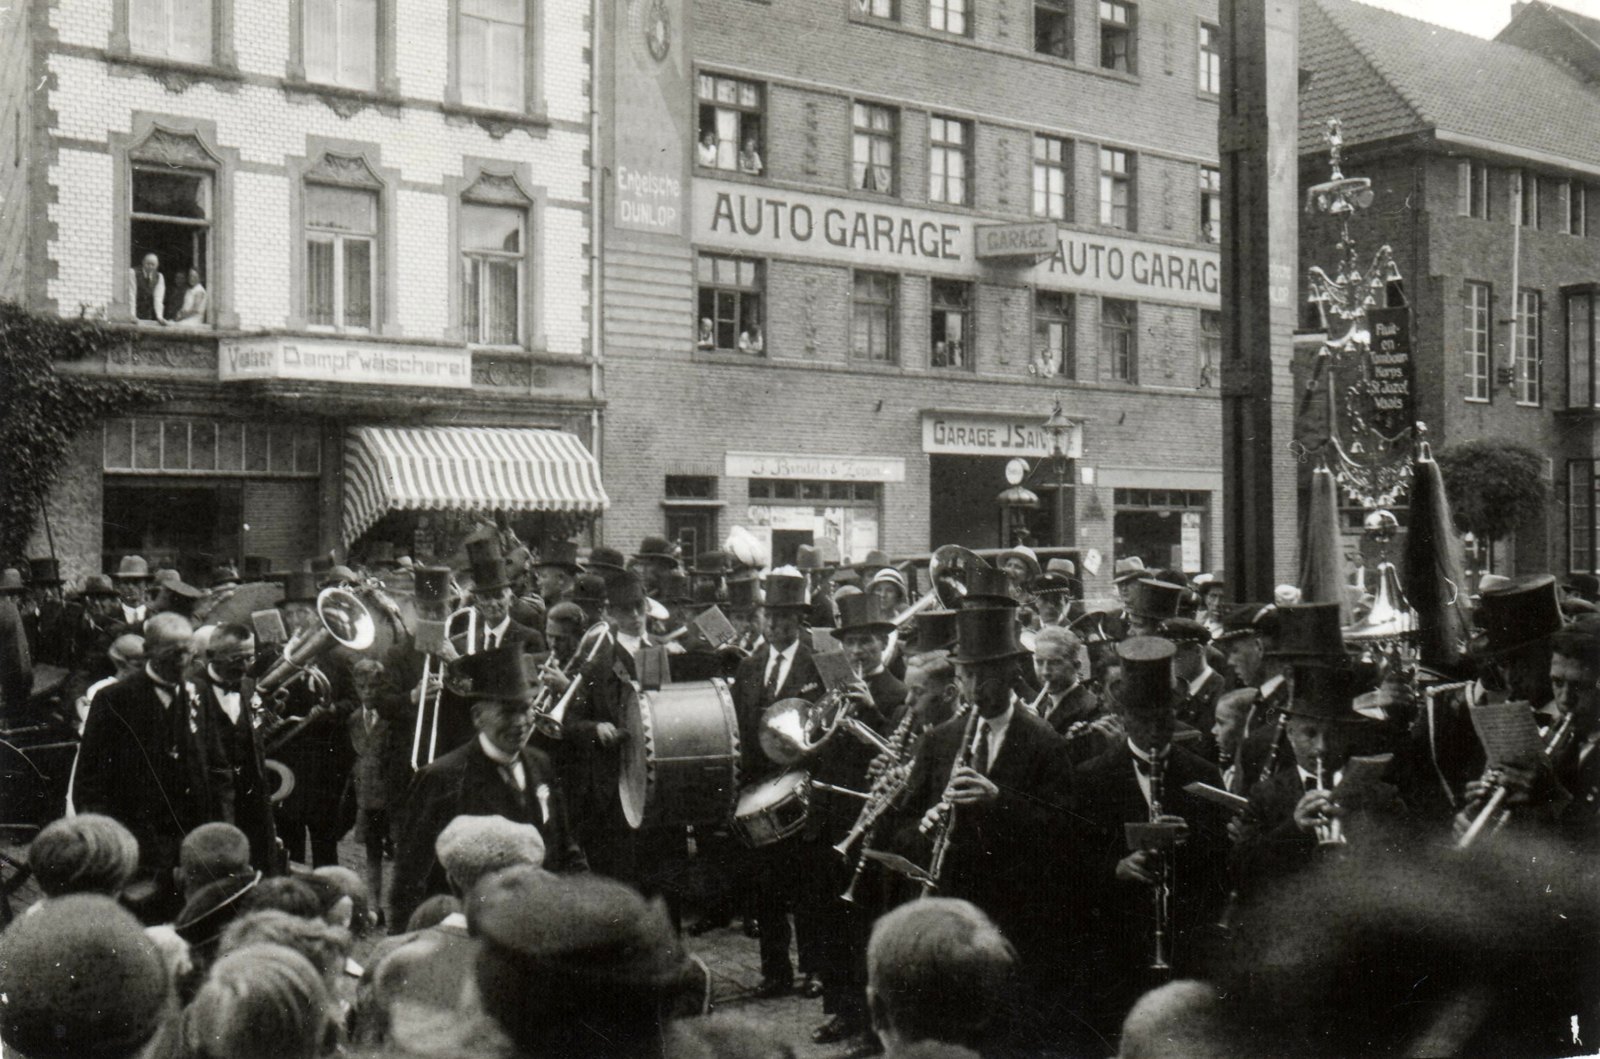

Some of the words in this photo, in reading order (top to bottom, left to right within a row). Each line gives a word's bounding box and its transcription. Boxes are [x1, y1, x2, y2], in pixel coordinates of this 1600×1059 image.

[620, 200, 677, 227] DUNLOP
[710, 192, 813, 242] AUTO
[824, 208, 961, 260] GARAGE
[987, 227, 1048, 250] GARAGE
[1048, 239, 1125, 281] AUTO
[1130, 250, 1222, 294] GARAG
[1380, 339, 1395, 351] en
[282, 345, 467, 377] Dampfwäscherei
[933, 420, 997, 447] GARAGE
